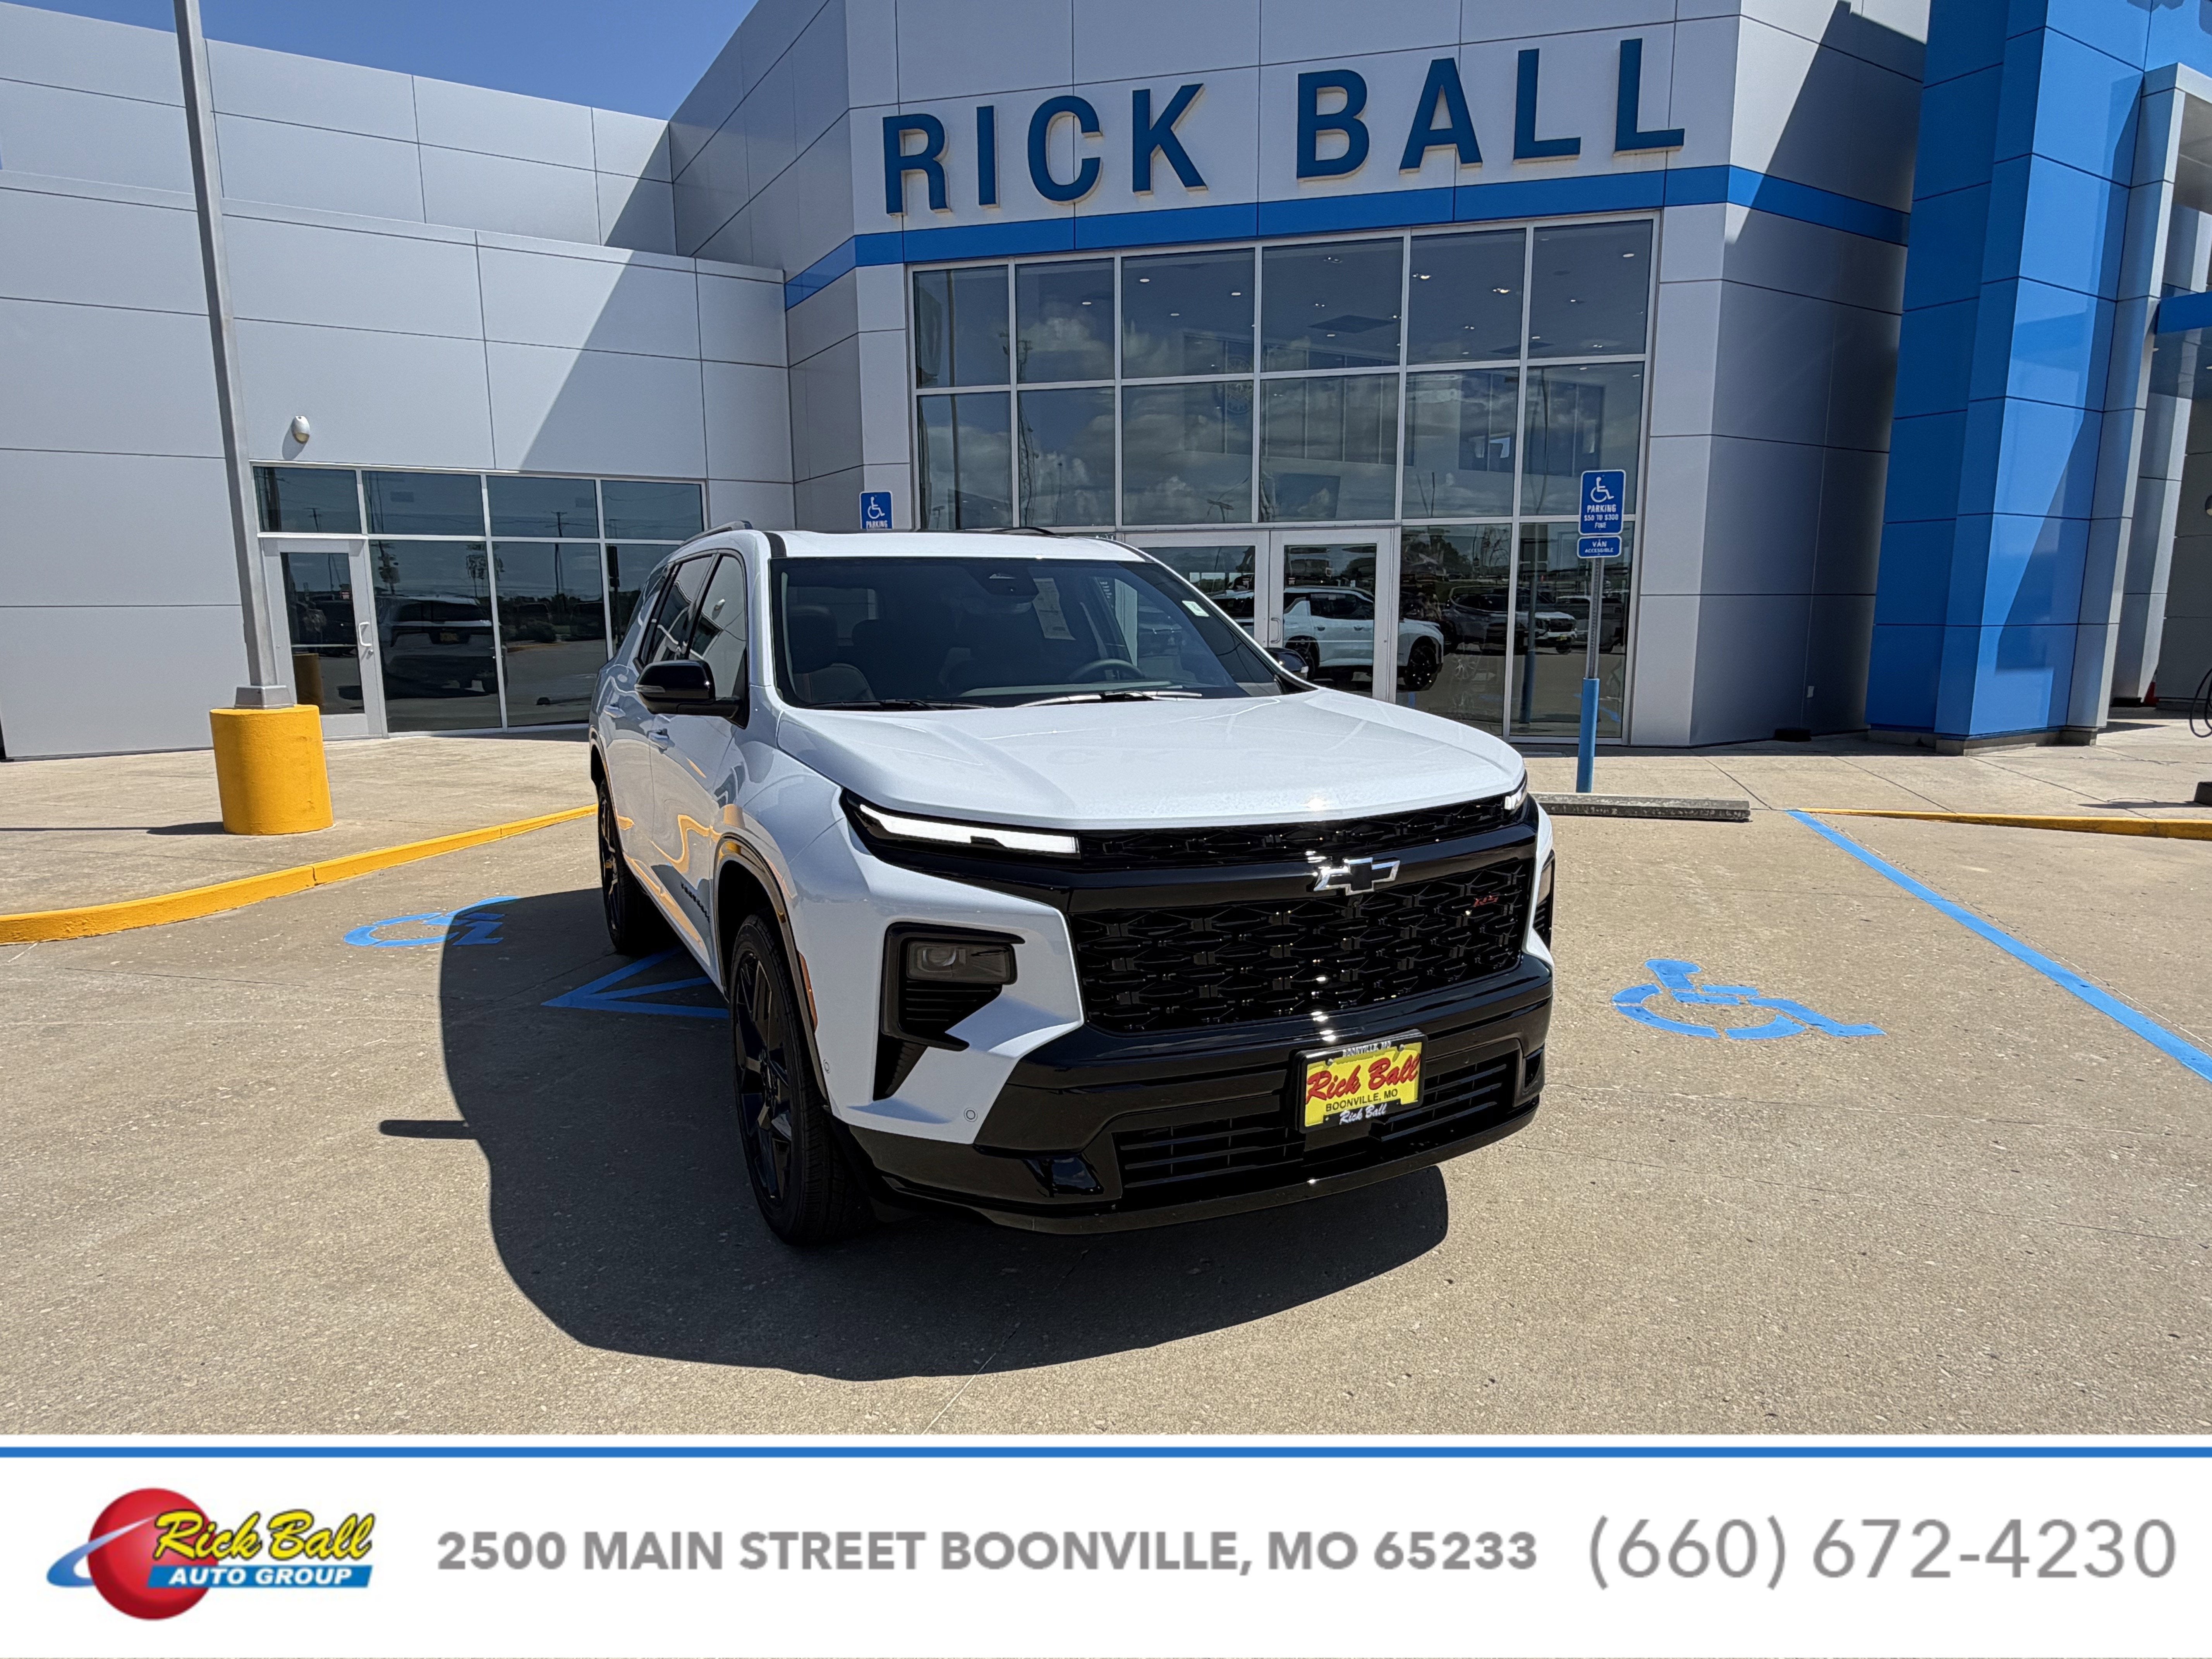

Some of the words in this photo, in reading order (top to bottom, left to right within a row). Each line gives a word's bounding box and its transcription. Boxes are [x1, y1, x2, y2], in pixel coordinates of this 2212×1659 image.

[882, 83, 1208, 217] RICK
[1295, 38, 1685, 181] BALL
[1587, 504, 1616, 513] PARKING
[1306, 1064, 1361, 1104] Rick
[1368, 1053, 1421, 1090] Ball
[1325, 1092, 1381, 1112] BOONVILLE,
[1384, 1088, 1398, 1099] MO
[1339, 1109, 1363, 1125] Rick
[1365, 1103, 1387, 1119] Ball
